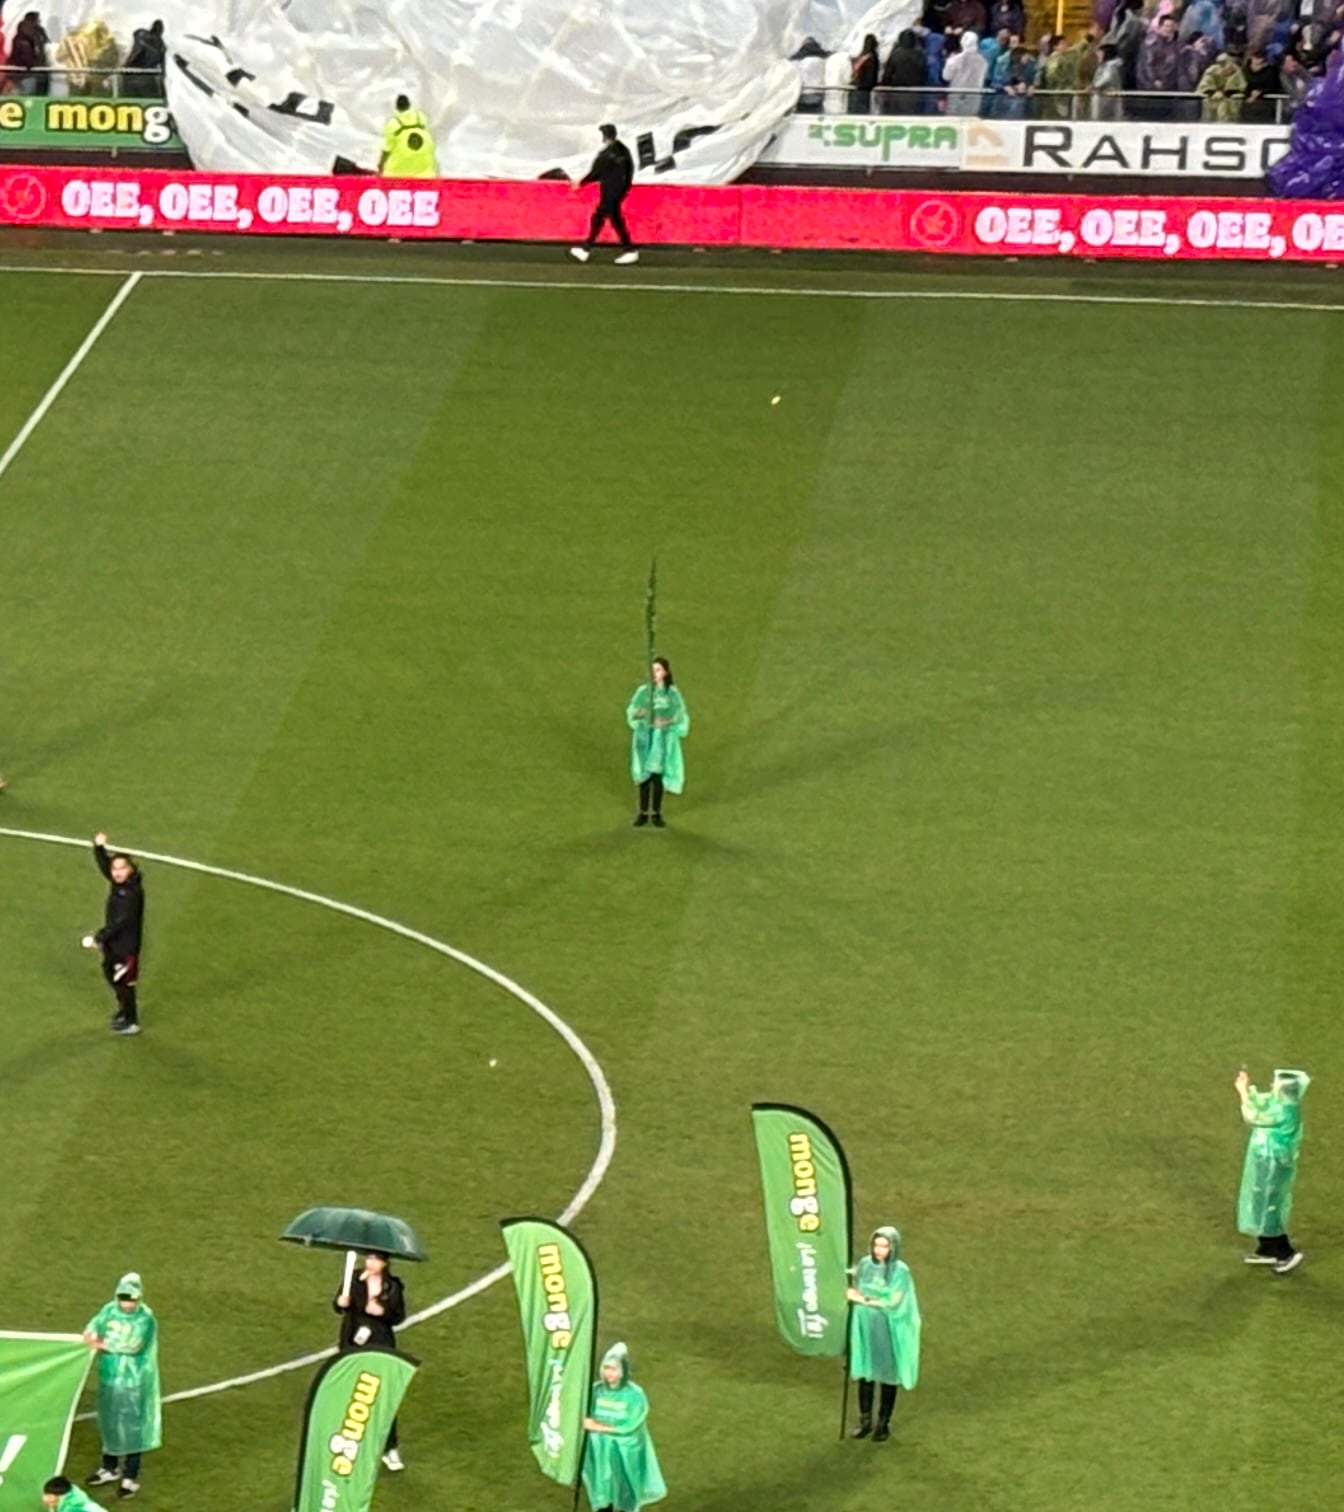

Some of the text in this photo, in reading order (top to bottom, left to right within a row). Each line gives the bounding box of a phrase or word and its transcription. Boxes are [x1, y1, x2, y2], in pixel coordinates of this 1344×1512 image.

[47, 102, 171, 144] mong
[60, 179, 441, 232] OEE, OEE, OEE, OEE
[974, 206, 1076, 253] OEE,
[1080, 208, 1181, 255] OEE,
[1187, 210, 1287, 258] OEE,
[790, 1133, 821, 1232] monge
[538, 1243, 571, 1350] monge
[329, 1372, 381, 1476] monge
